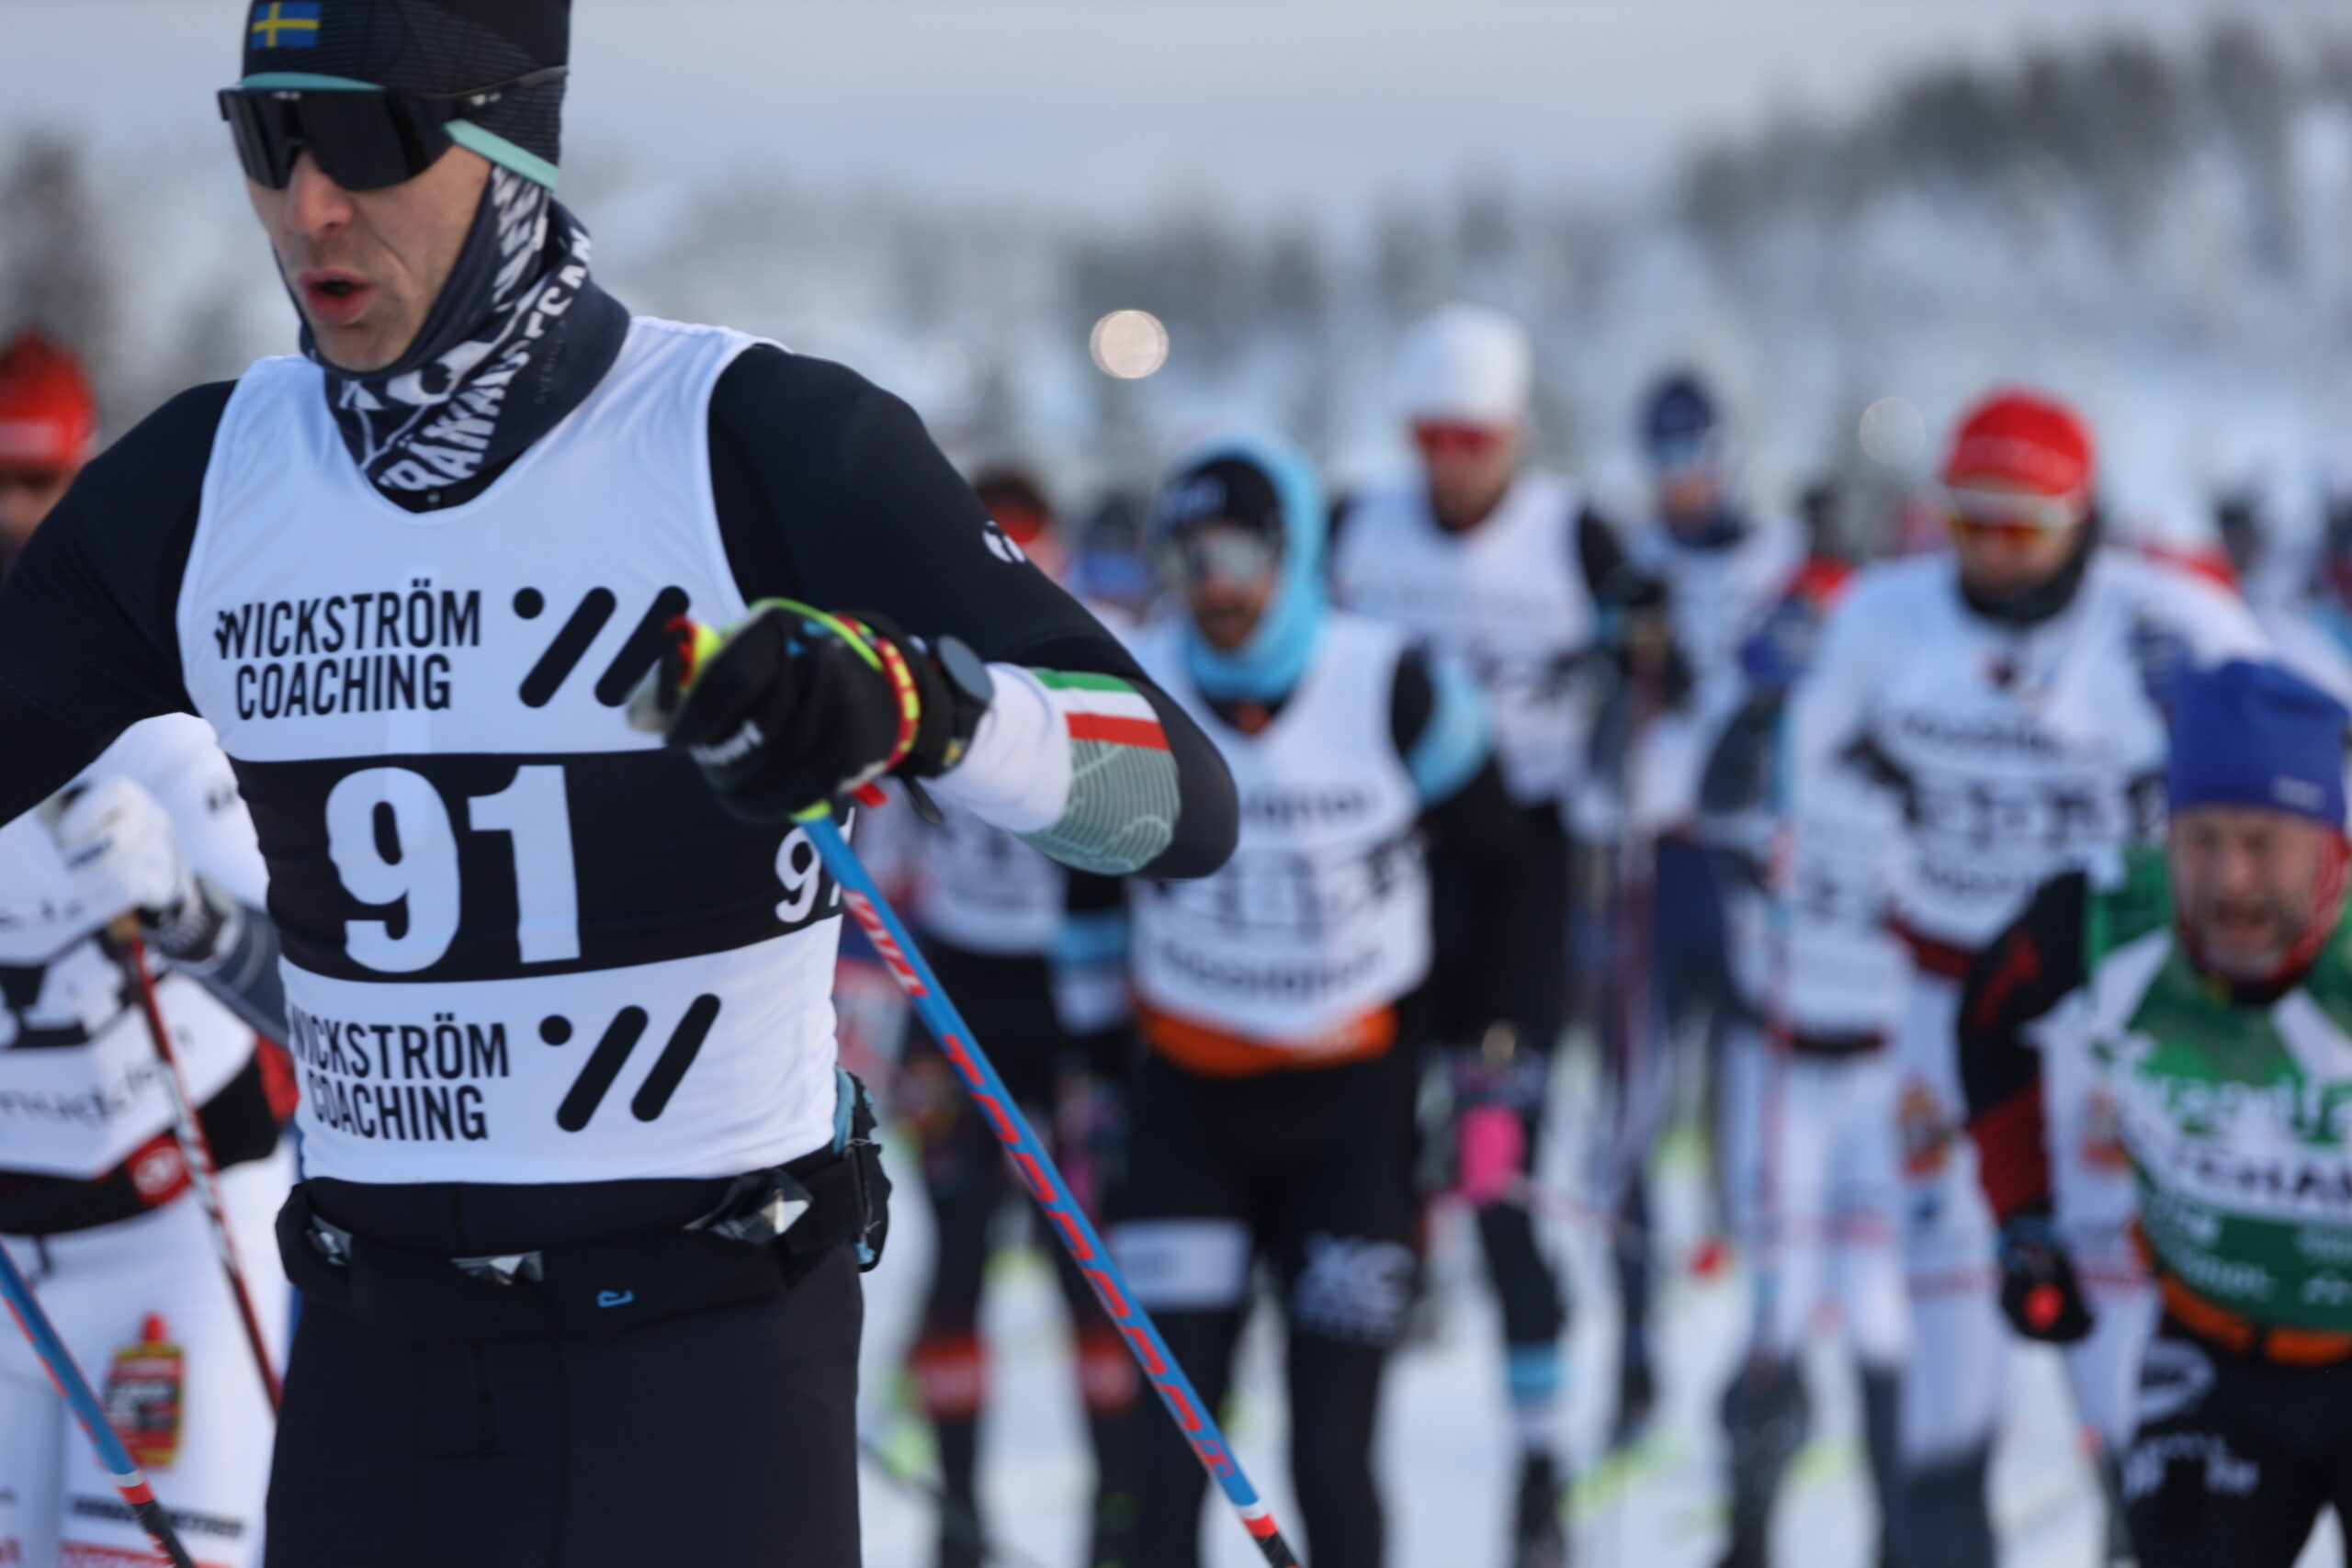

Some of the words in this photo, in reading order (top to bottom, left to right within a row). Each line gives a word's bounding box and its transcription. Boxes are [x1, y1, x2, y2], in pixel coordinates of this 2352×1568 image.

[214, 578, 481, 660] WICKSTRÖM
[236, 653, 451, 721] COACHING
[324, 766, 581, 974] 91
[307, 1067, 489, 1142] COACHING
